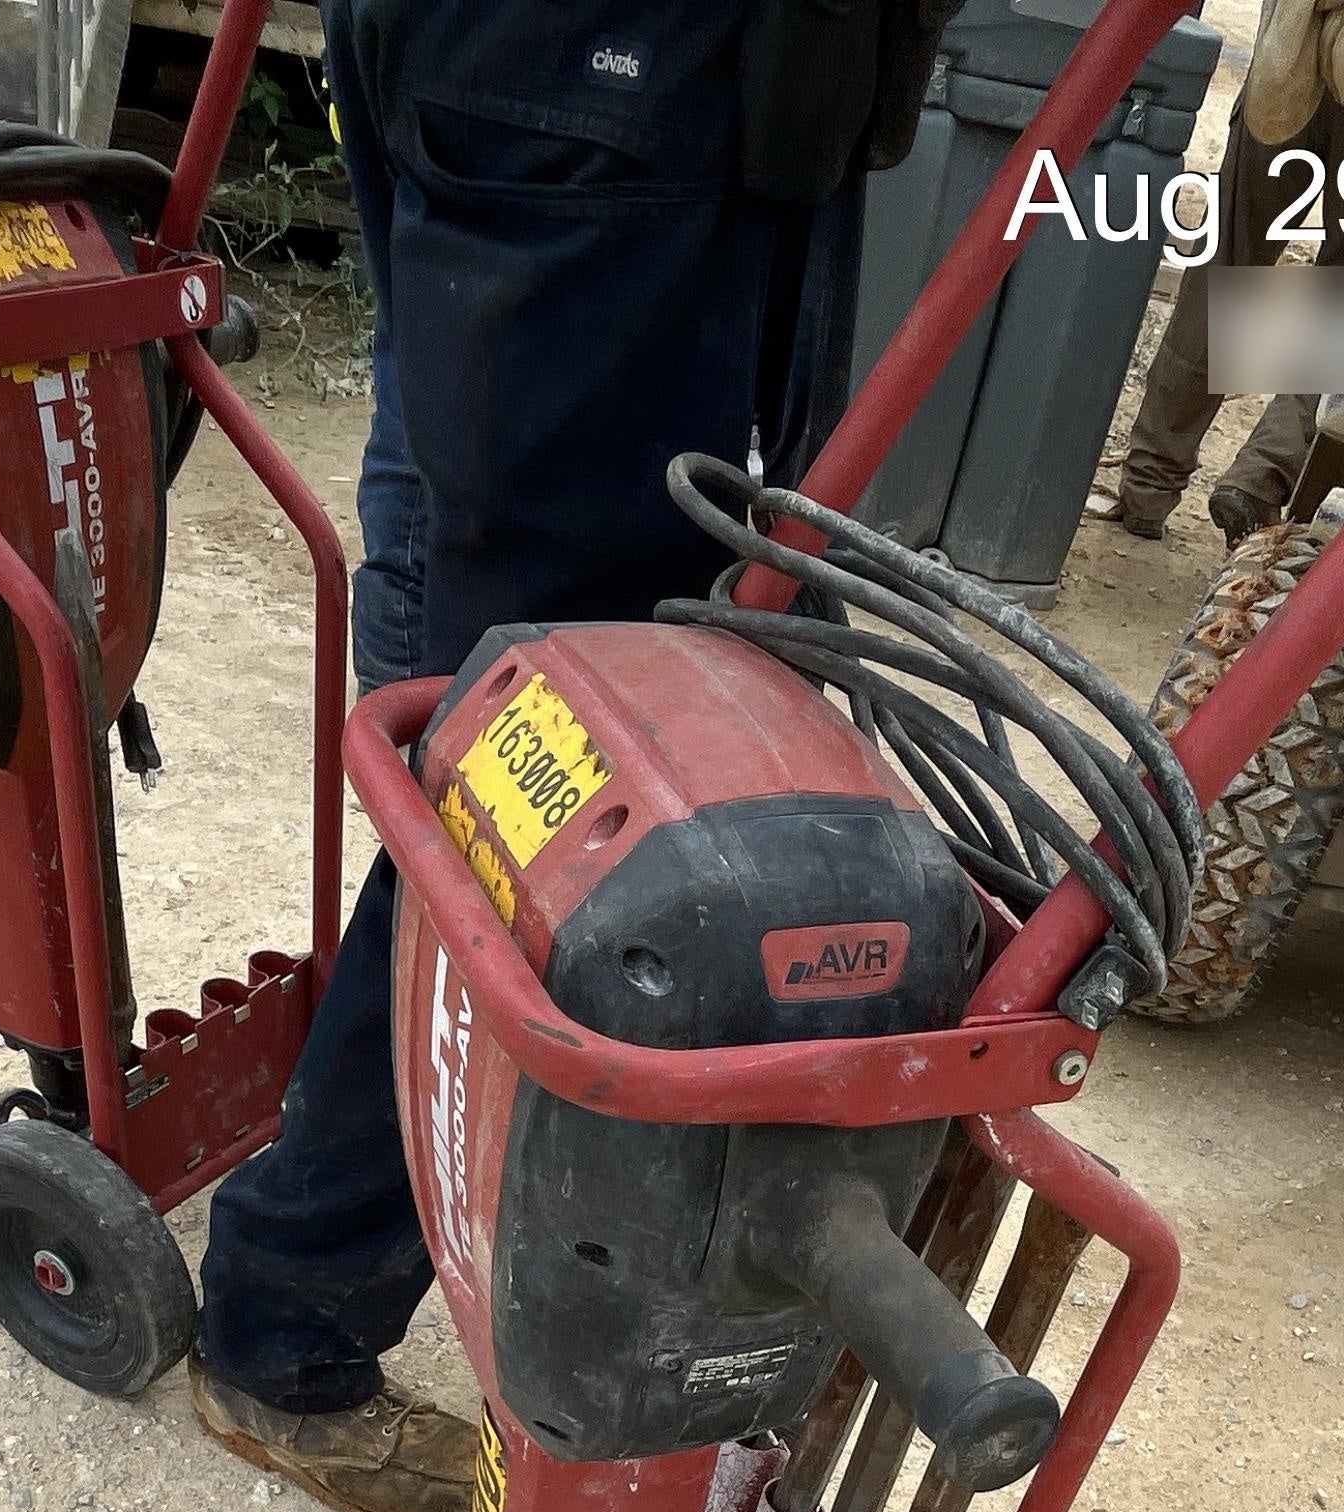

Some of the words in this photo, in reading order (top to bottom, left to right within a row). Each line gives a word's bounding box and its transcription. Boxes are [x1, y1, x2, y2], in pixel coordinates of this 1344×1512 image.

[818, 939, 888, 974] AVR
[431, 944, 464, 1265] HILT
[454, 986, 473, 1208] 3000-AV
